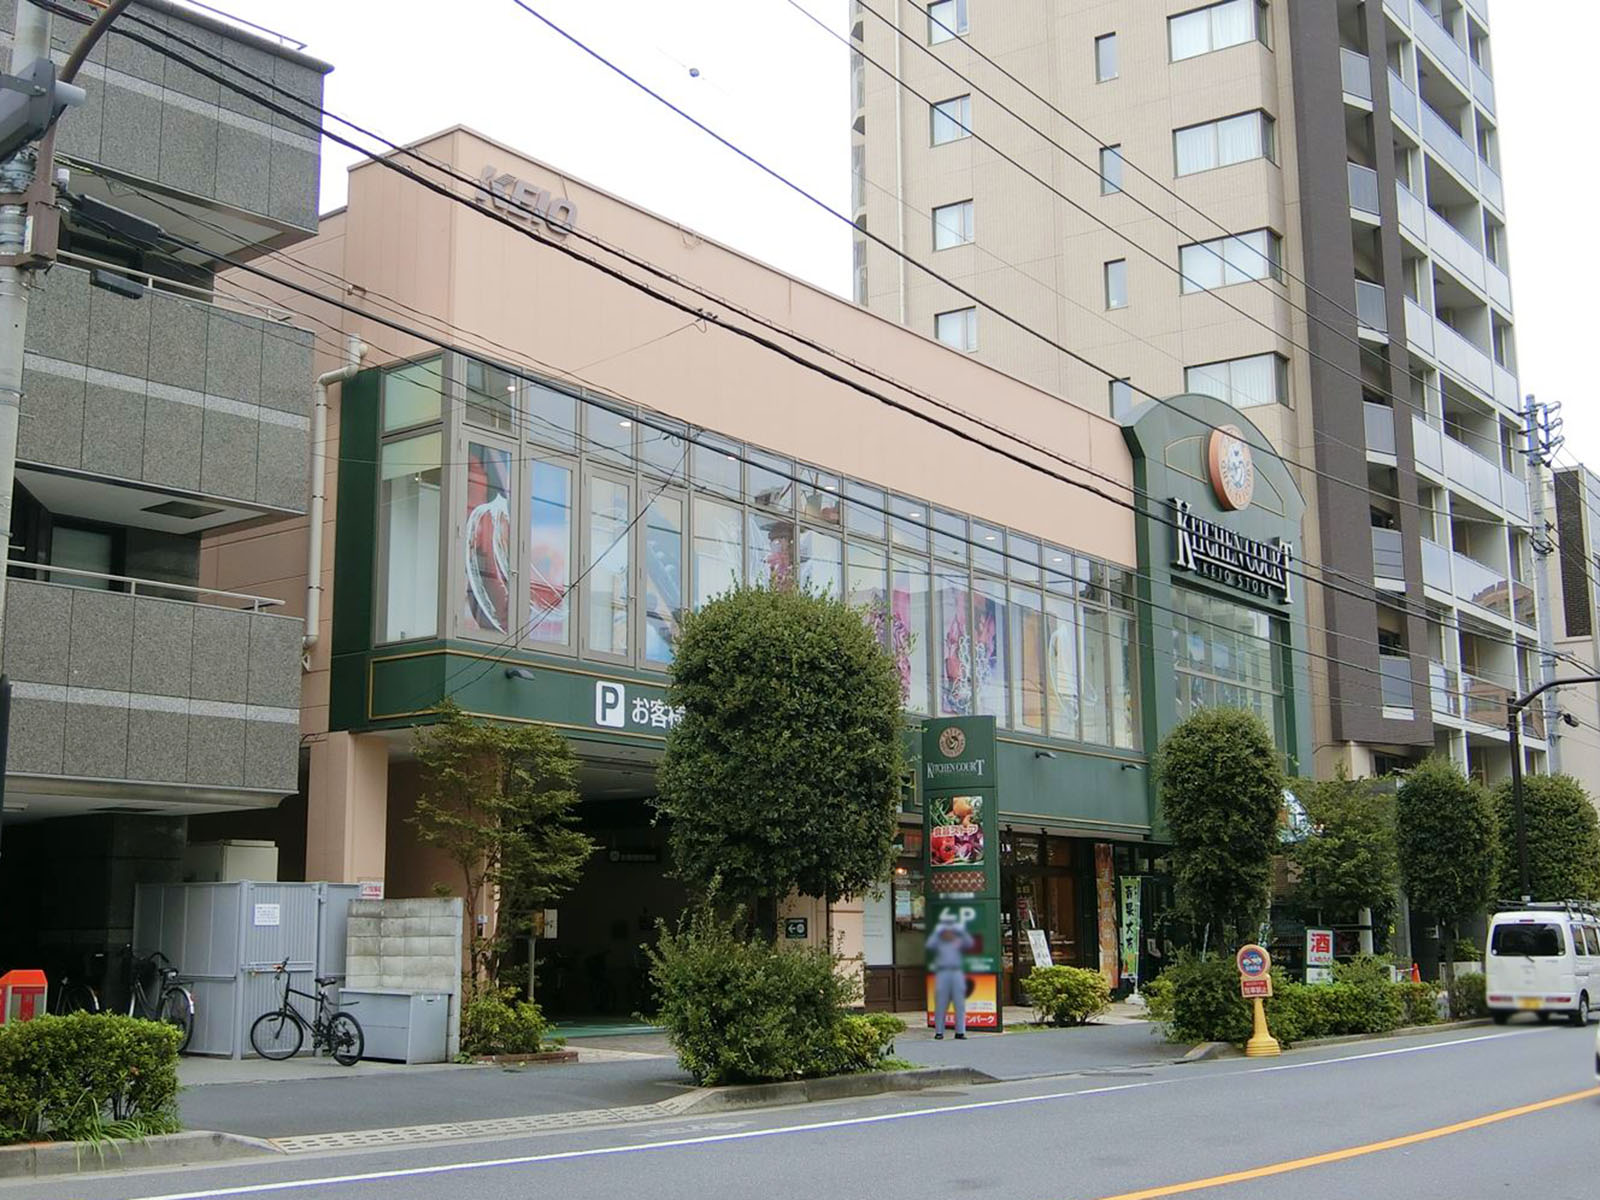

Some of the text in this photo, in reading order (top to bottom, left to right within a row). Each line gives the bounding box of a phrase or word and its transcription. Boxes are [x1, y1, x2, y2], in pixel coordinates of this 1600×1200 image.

[475, 165, 577, 236] KEIO
[1202, 562, 1272, 598] KEIO STORE
[600, 684, 620, 722] P
[927, 759, 985, 778] KITCHEN COURT
[1311, 933, 1330, 953] 酒
